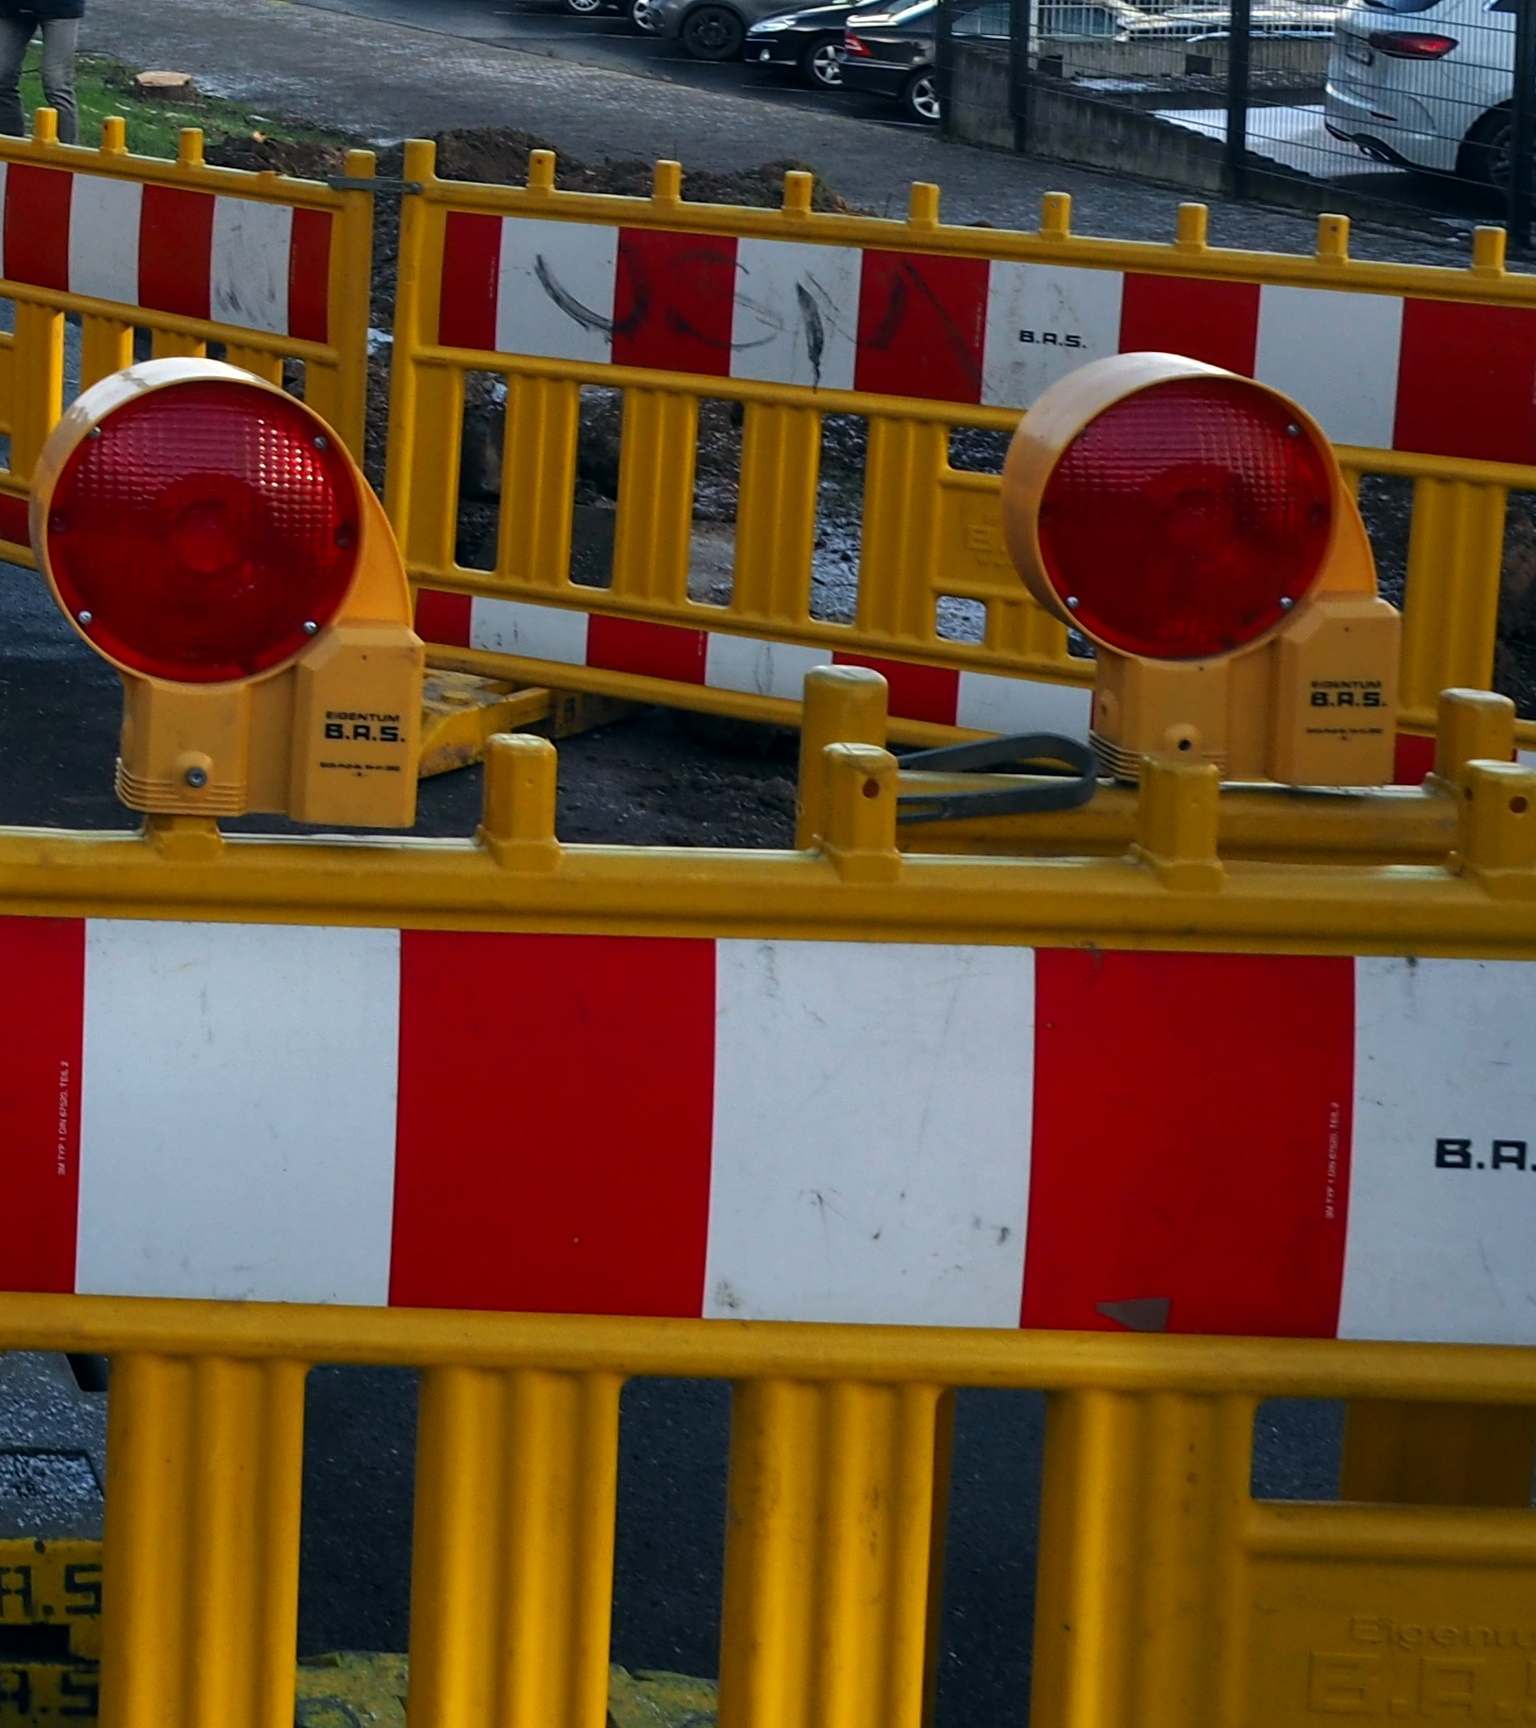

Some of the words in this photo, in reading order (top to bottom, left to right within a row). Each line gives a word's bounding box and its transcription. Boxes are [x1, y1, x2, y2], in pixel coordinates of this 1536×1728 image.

[1018, 329, 1088, 349] B.A.S.
[1310, 691, 1388, 707] B.A.S.
[324, 723, 406, 743] B.A.S.
[1434, 1137, 1536, 1173] B.A.
